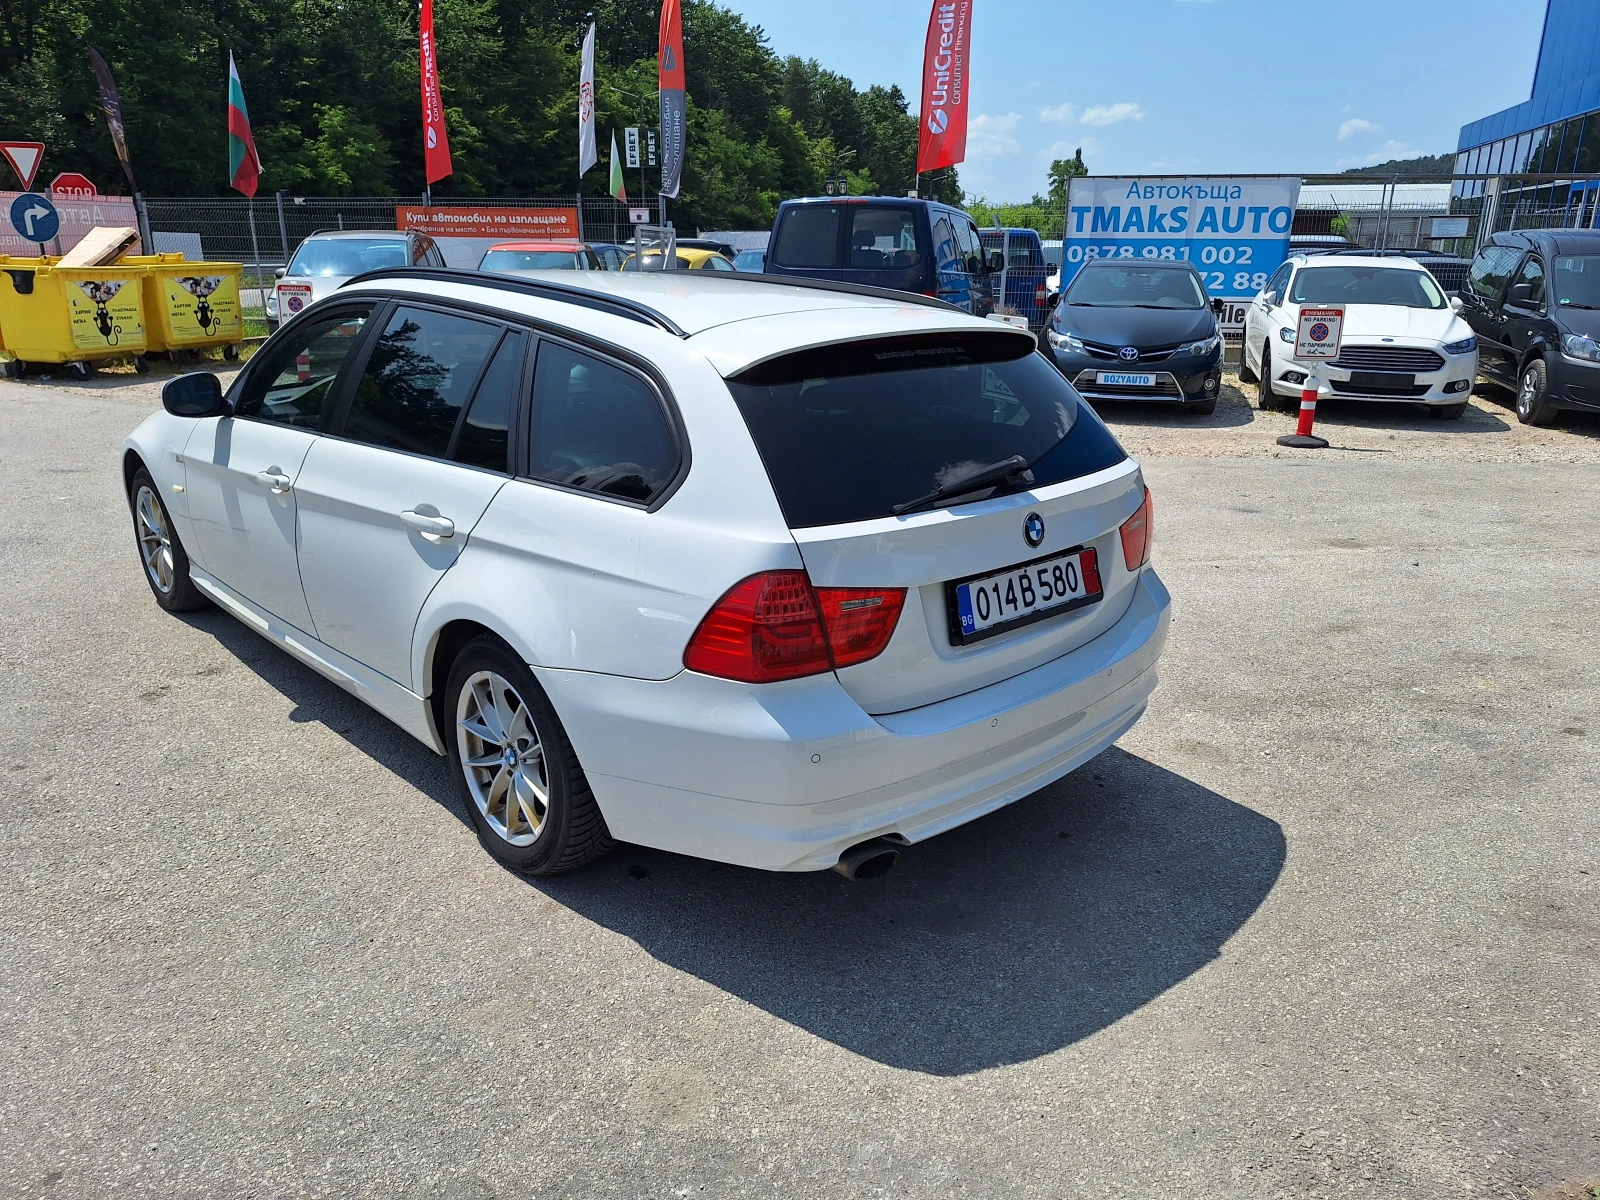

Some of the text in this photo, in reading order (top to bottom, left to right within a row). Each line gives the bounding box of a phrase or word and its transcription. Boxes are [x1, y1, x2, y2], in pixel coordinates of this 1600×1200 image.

[931, 3, 955, 106] UniCredit
[951, 1, 968, 105] Consumer Financing
[628, 131, 637, 165] EFBET
[647, 130, 656, 165] EFBET
[1125, 180, 1241, 202] Автокъща
[406, 212, 567, 225] Купи автомобил на изплащане
[1071, 204, 1292, 234] TMAkS AUTO
[1067, 245, 1134, 263] 0878
[1201, 246, 1253, 264] 002
[1103, 374, 1149, 384] BOZYAUTO
[961, 614, 973, 626] BG
